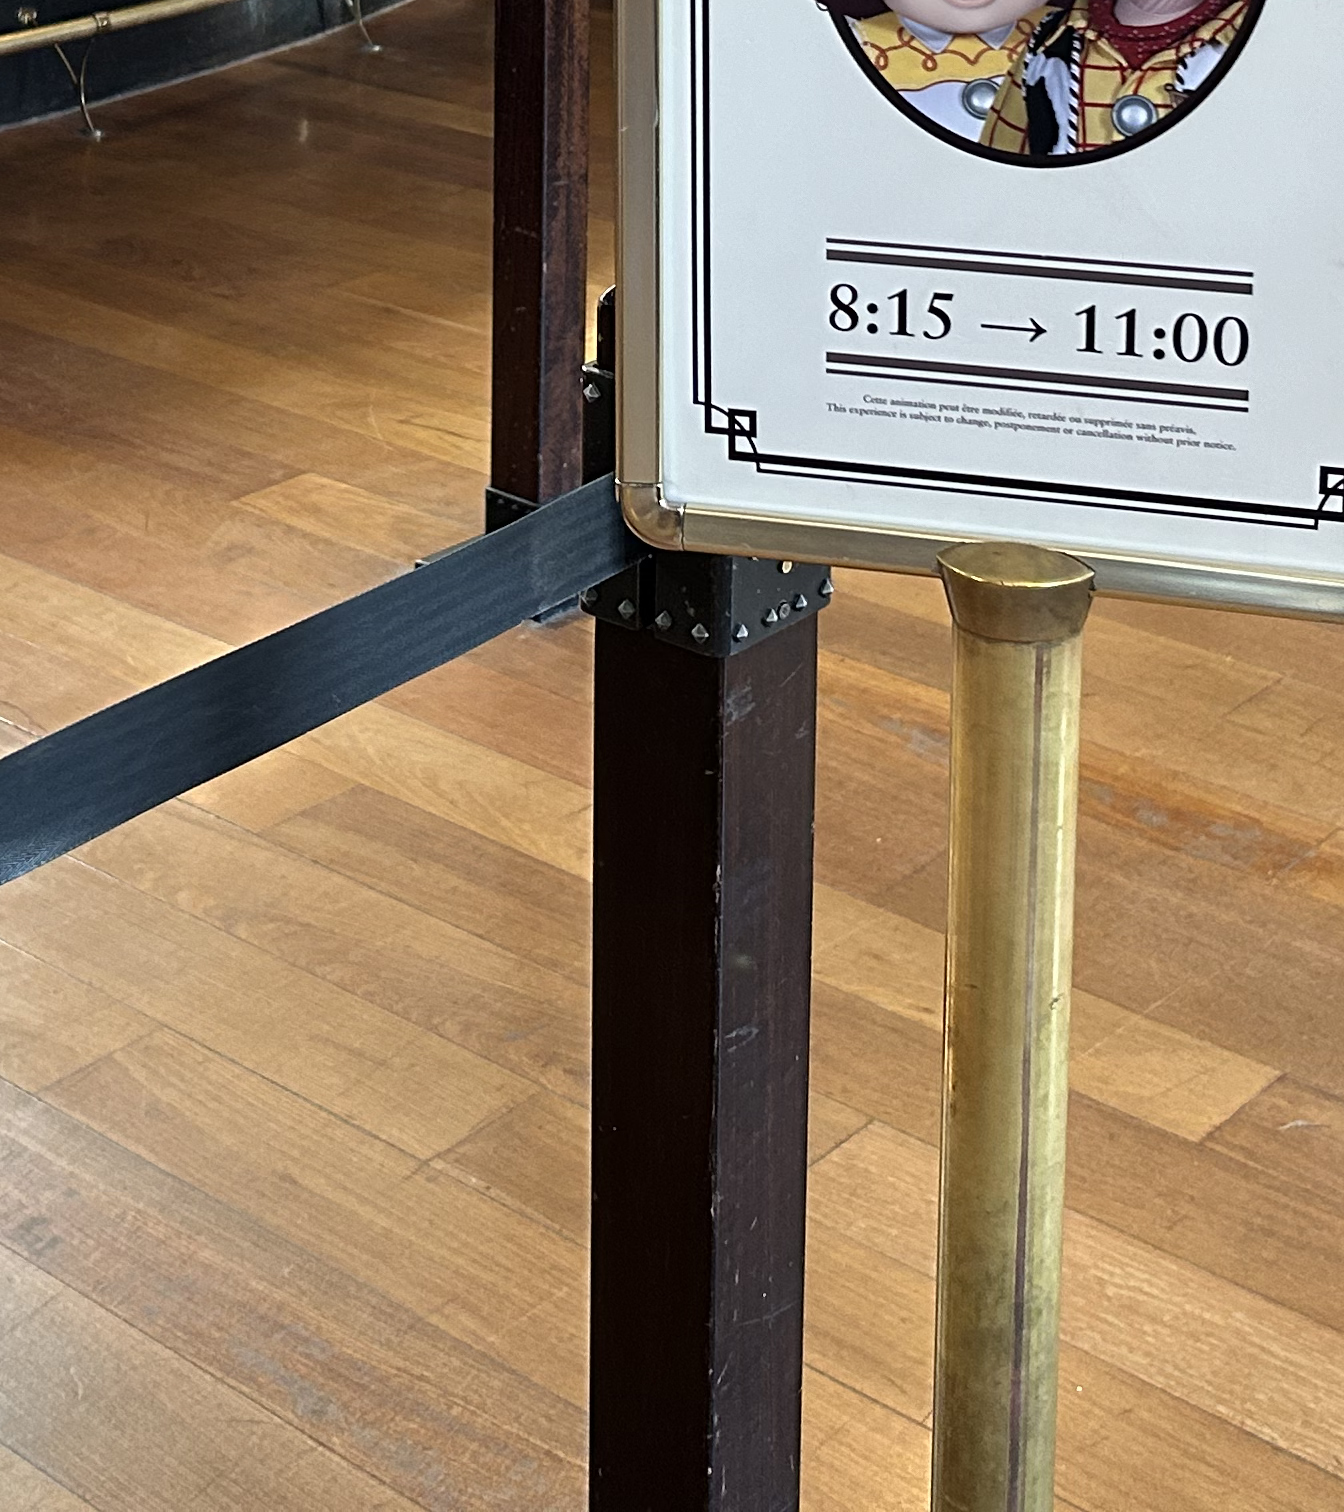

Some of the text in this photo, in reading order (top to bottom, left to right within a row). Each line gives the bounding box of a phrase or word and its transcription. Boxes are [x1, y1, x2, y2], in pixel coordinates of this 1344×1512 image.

[828, 283, 1250, 367] 8:15 11:00
[862, 394, 887, 404] Cette
[890, 398, 936, 409] animation
[826, 402, 846, 412] This
[848, 407, 896, 417] experience
[909, 411, 941, 422] subject
[956, 415, 992, 427] change,
[1076, 429, 1133, 440] cancellation
[1136, 433, 1173, 444] without
[1176, 438, 1200, 447] prior
[1203, 441, 1236, 450] notice.
